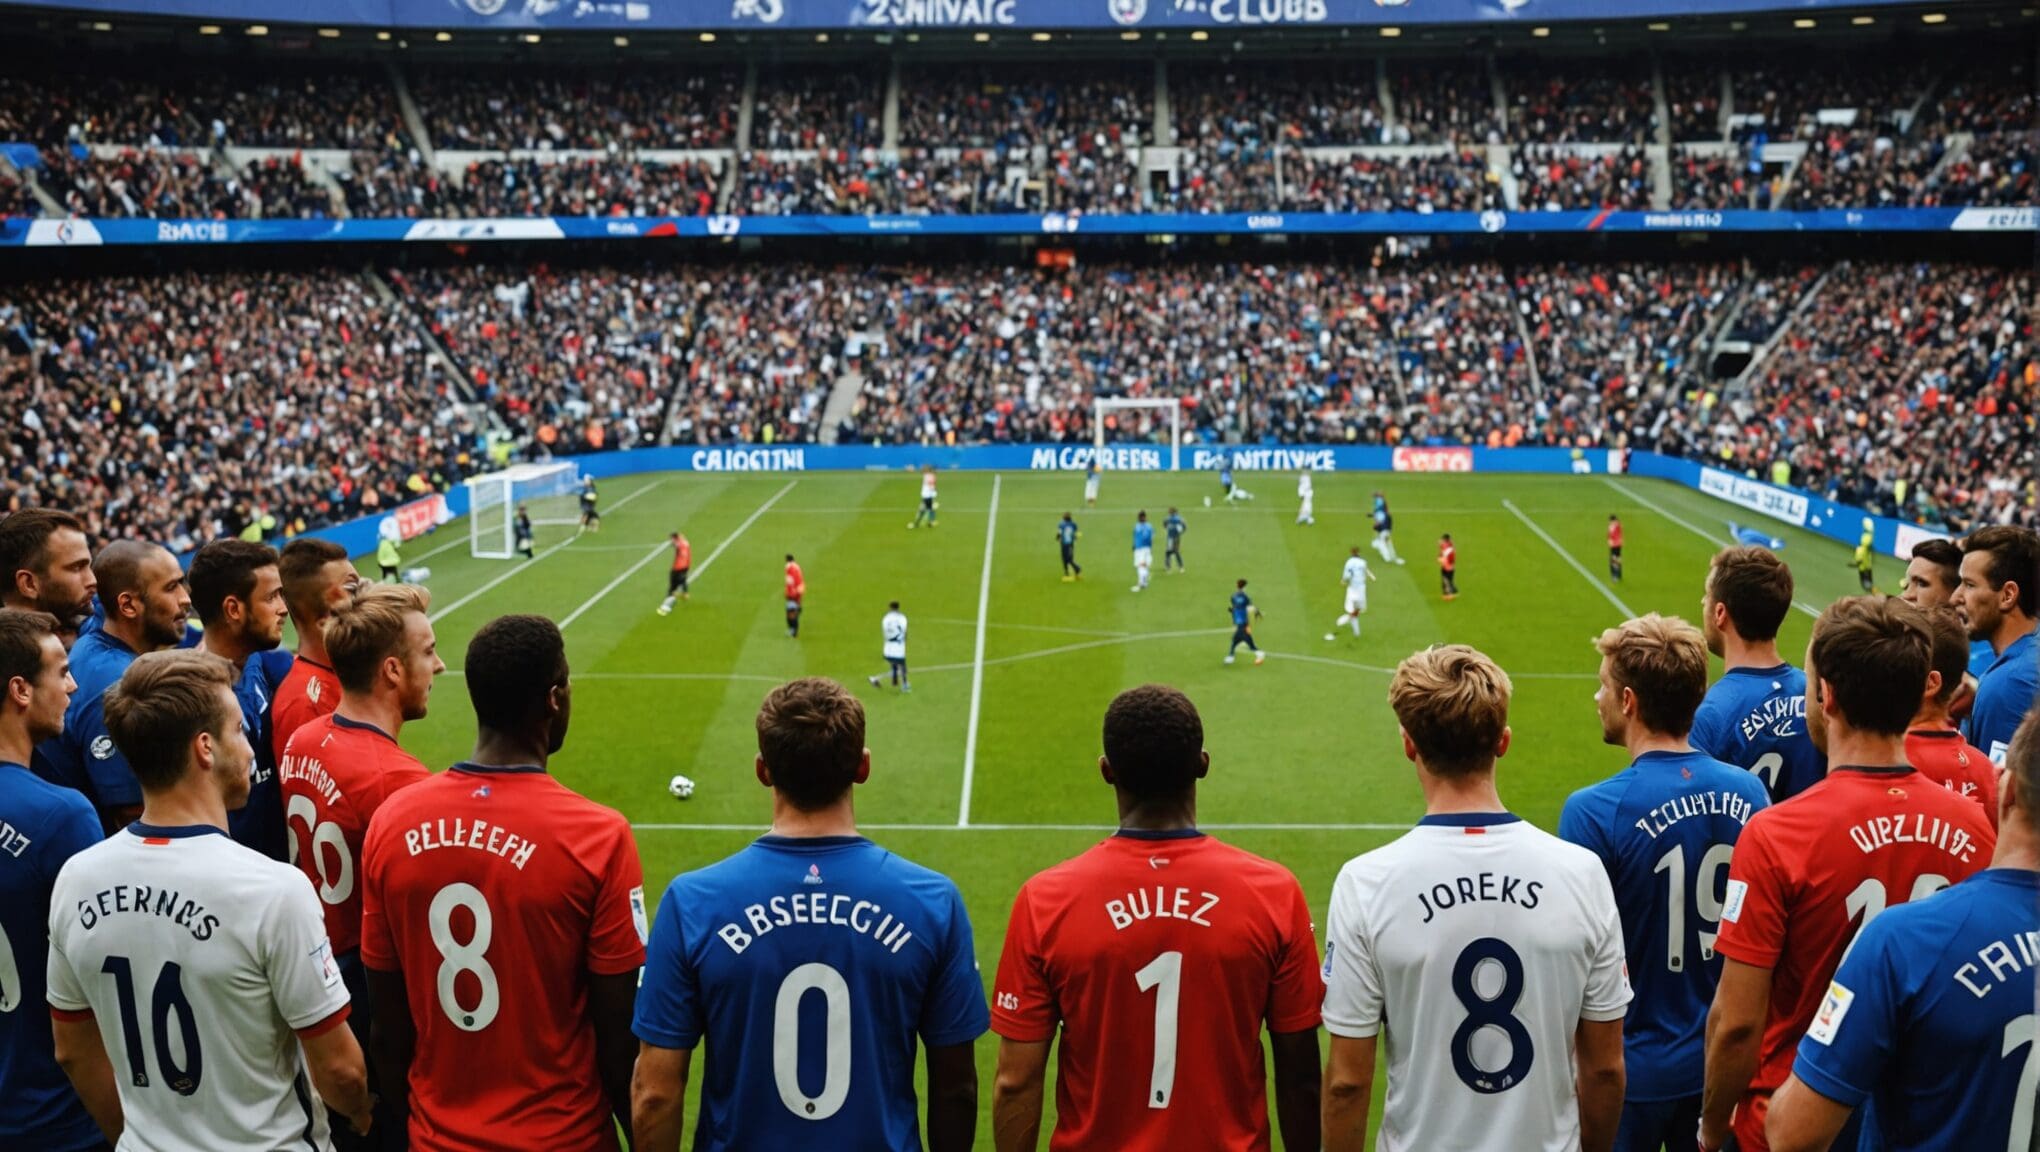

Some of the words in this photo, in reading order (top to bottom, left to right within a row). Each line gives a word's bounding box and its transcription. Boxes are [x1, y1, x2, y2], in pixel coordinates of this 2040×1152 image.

[429, 882, 500, 1032] 8
[1105, 886, 1220, 930] BULEZ
[1417, 872, 1544, 923] JOREKS
[1653, 843, 1735, 973] 19
[773, 962, 851, 1120] 0
[1135, 951, 1183, 1109] 1
[1451, 937, 1534, 1094] 8
